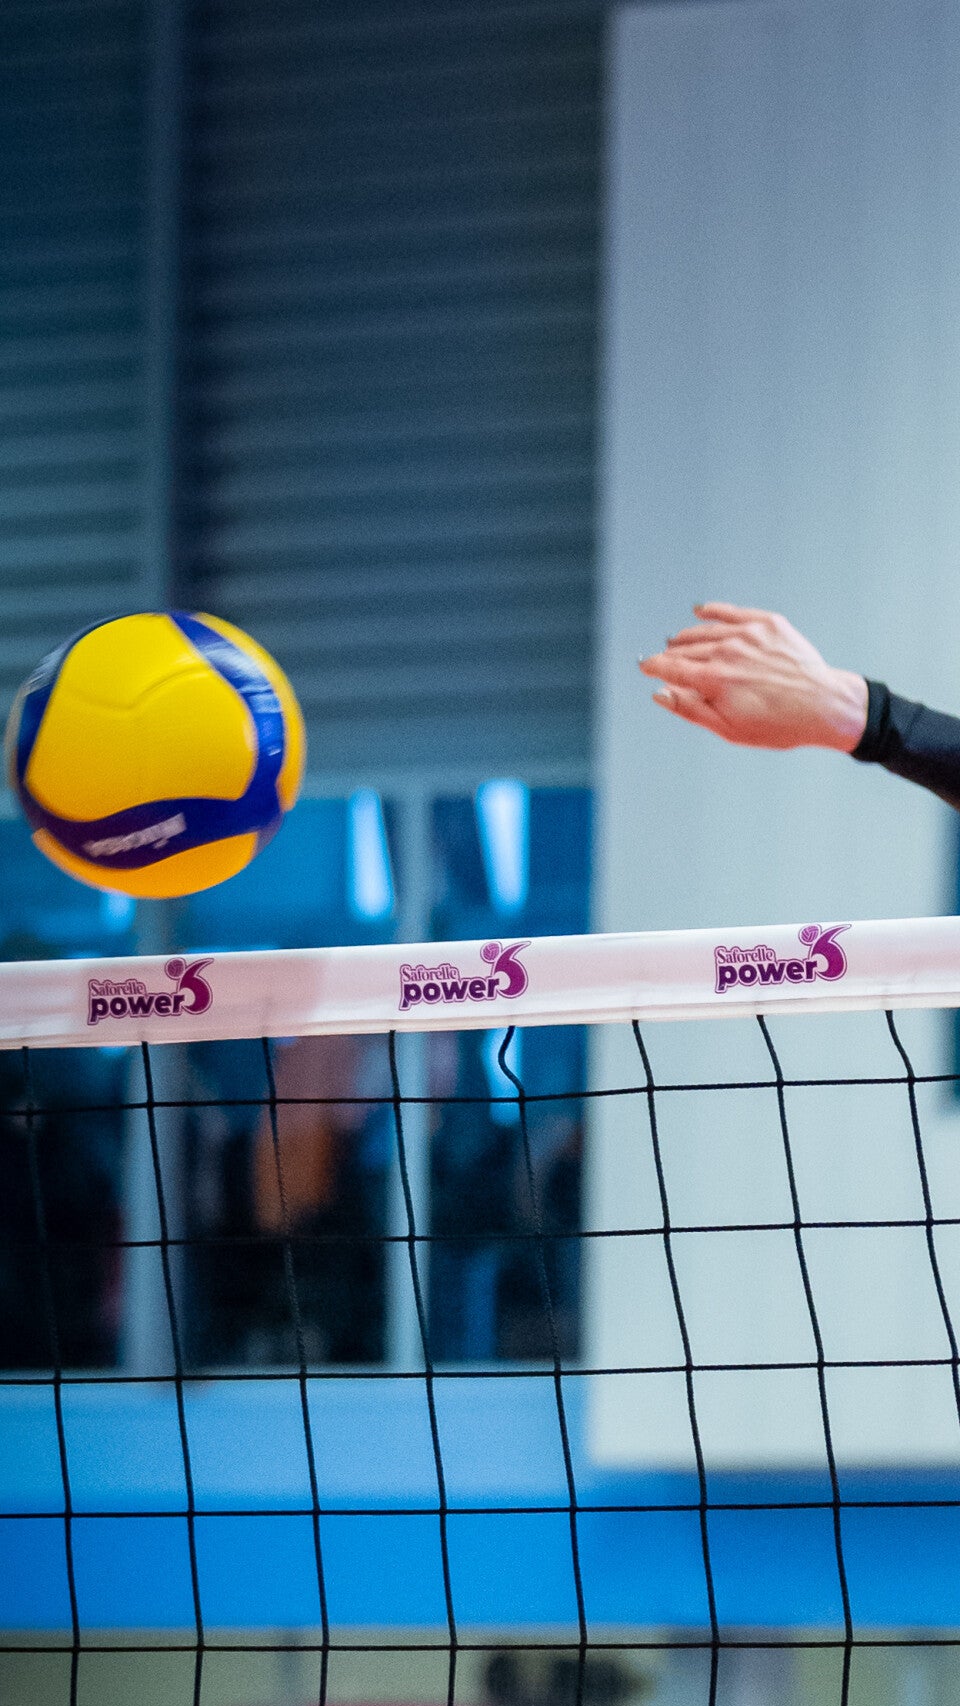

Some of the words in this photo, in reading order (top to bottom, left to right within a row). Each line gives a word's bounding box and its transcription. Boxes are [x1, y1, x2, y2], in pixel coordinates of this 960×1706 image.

[716, 947, 773, 963] Saforelle
[401, 965, 457, 981] Saforelle
[718, 960, 818, 990] power
[91, 980, 144, 996] Saforelle
[402, 979, 499, 1008] power
[90, 994, 185, 1022] power
